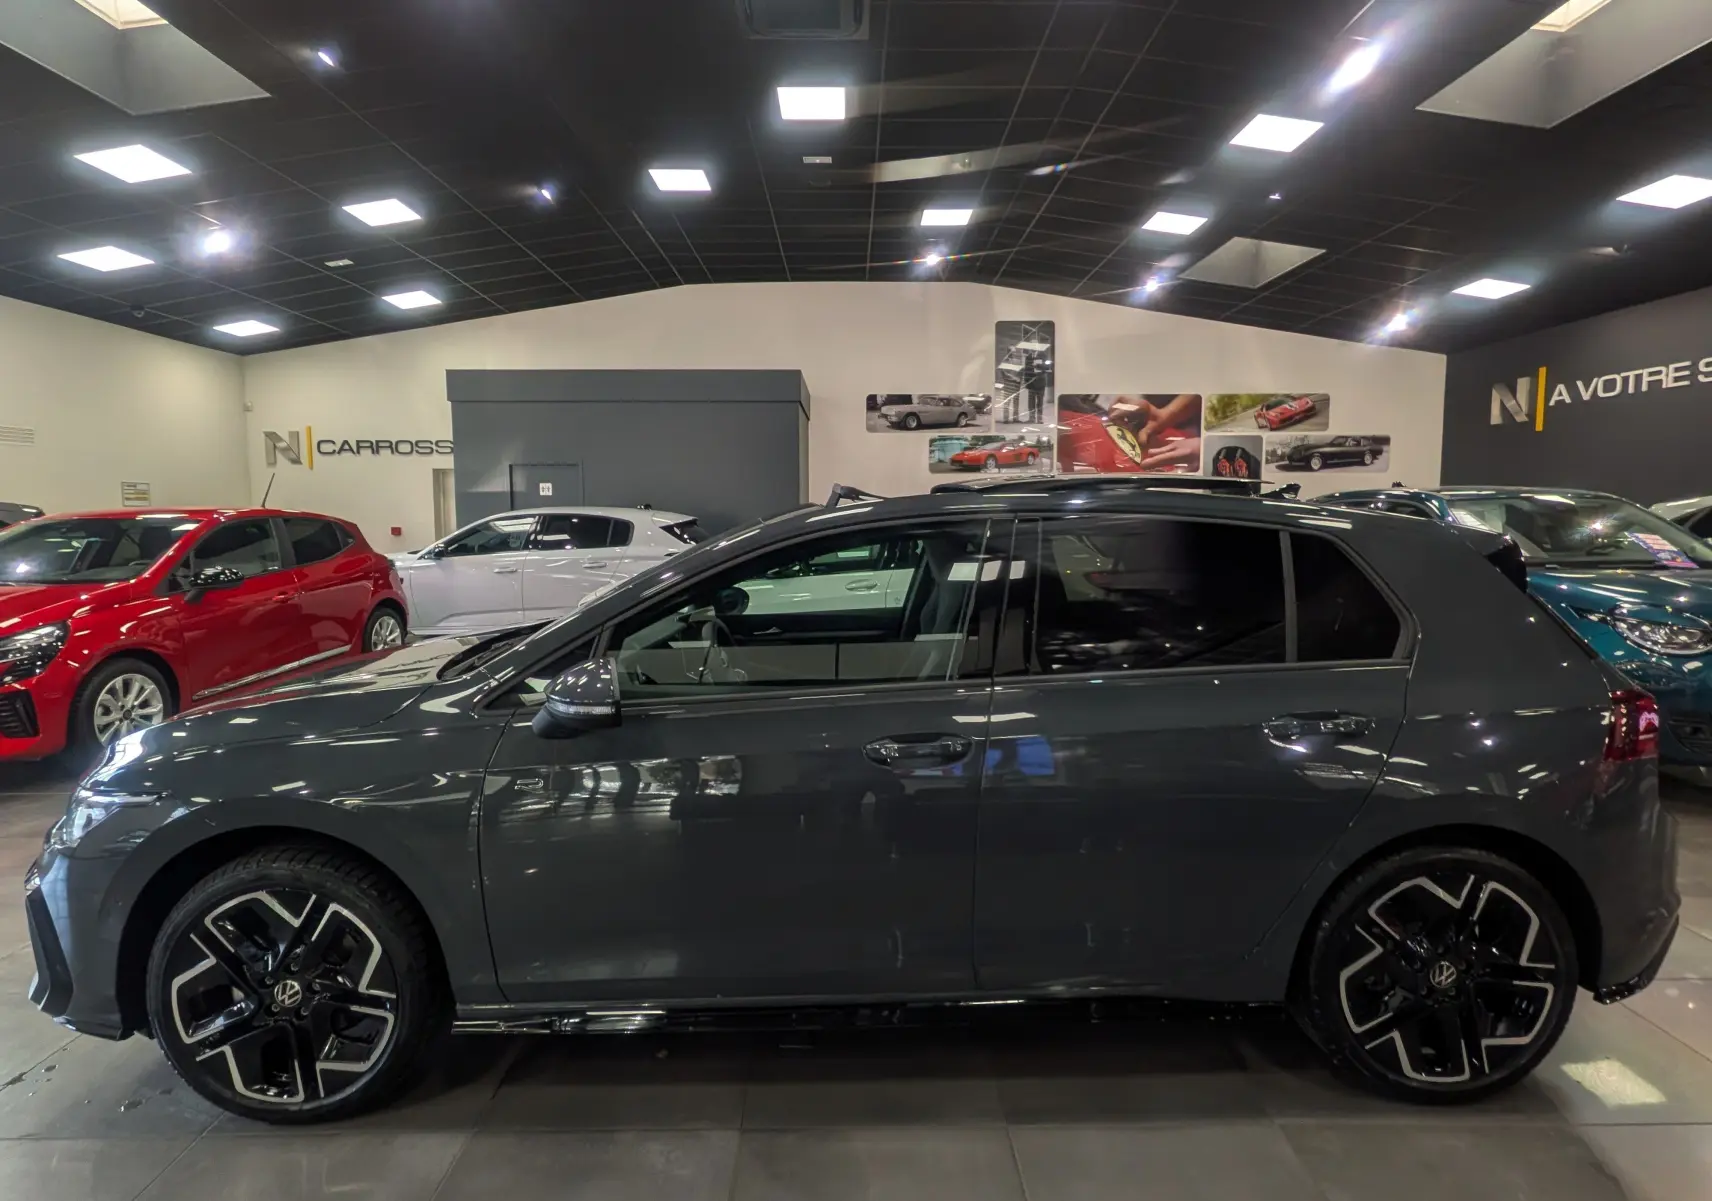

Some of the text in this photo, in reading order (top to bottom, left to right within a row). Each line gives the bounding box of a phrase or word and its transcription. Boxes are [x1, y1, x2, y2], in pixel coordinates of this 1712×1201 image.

[1549, 383, 1572, 406] A
[1576, 361, 1692, 400] VOTRE
[316, 439, 454, 456] CARROSS
